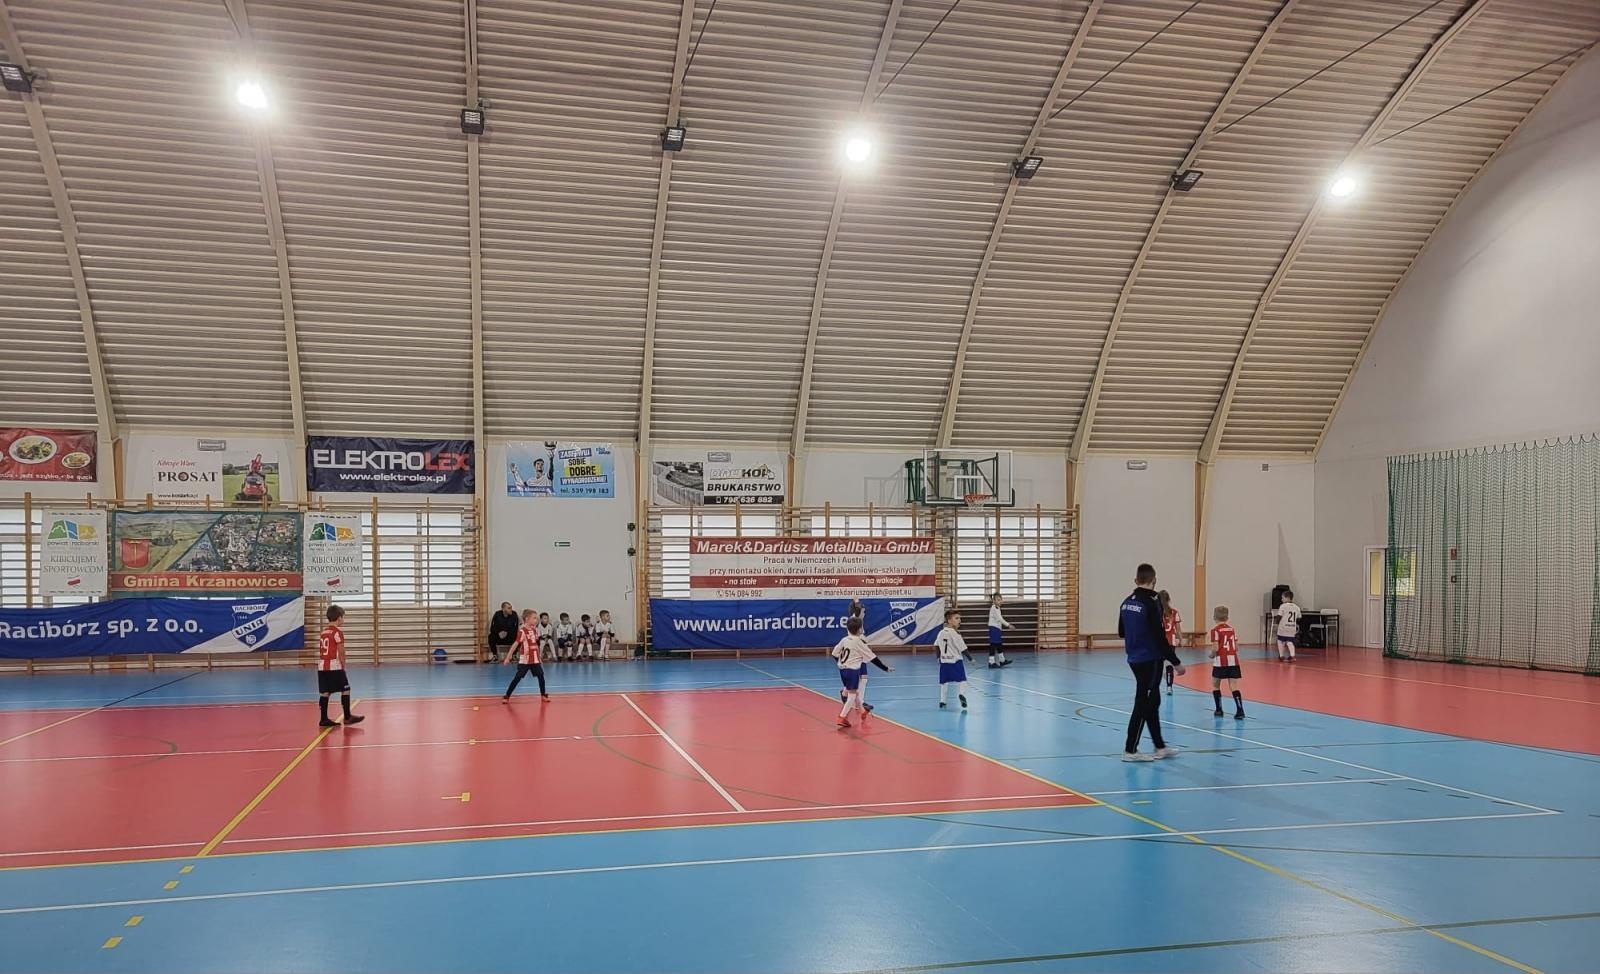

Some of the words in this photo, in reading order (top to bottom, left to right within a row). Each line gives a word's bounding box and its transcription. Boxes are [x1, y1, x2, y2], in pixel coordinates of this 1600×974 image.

[313, 449, 470, 471] ELEKTROLEX
[568, 458, 587, 466] SOBIE
[158, 471, 219, 482] PROSAT
[569, 466, 597, 476] DOBRE
[339, 473, 448, 484] www.elektrolex.pl
[707, 483, 782, 491] BRUKARSTWO
[697, 540, 808, 553] Marek&Dariusz
[813, 541, 881, 553] Metallbau
[886, 541, 930, 553] GmbH
[50, 555, 98, 563] KIBICUJEMY
[311, 556, 354, 564] KIBICUJEMY
[763, 556, 785, 564] Praca
[795, 556, 836, 564] Niemczech
[842, 556, 867, 564] Austrii
[43, 565, 104, 573] SPORTOWCOM
[306, 565, 360, 573] SPORTOWCOM
[709, 568, 726, 576] przy
[814, 566, 835, 574] fasad
[836, 566, 918, 575] aluminiowo-szklanych
[123, 575, 180, 587] Gmina
[186, 575, 289, 587] Krzanowice
[751, 589, 763, 597] 992
[673, 612, 849, 632] www.uniaraciborz.e
[891, 615, 914, 630] UNIA
[1287, 611, 1296, 623] 21
[0, 619, 100, 639] Racibórz
[107, 618, 139, 640] sp.
[147, 618, 159, 632] z
[165, 619, 203, 633] o.o.
[235, 618, 265, 636] UNIA
[943, 638, 948, 654] 7
